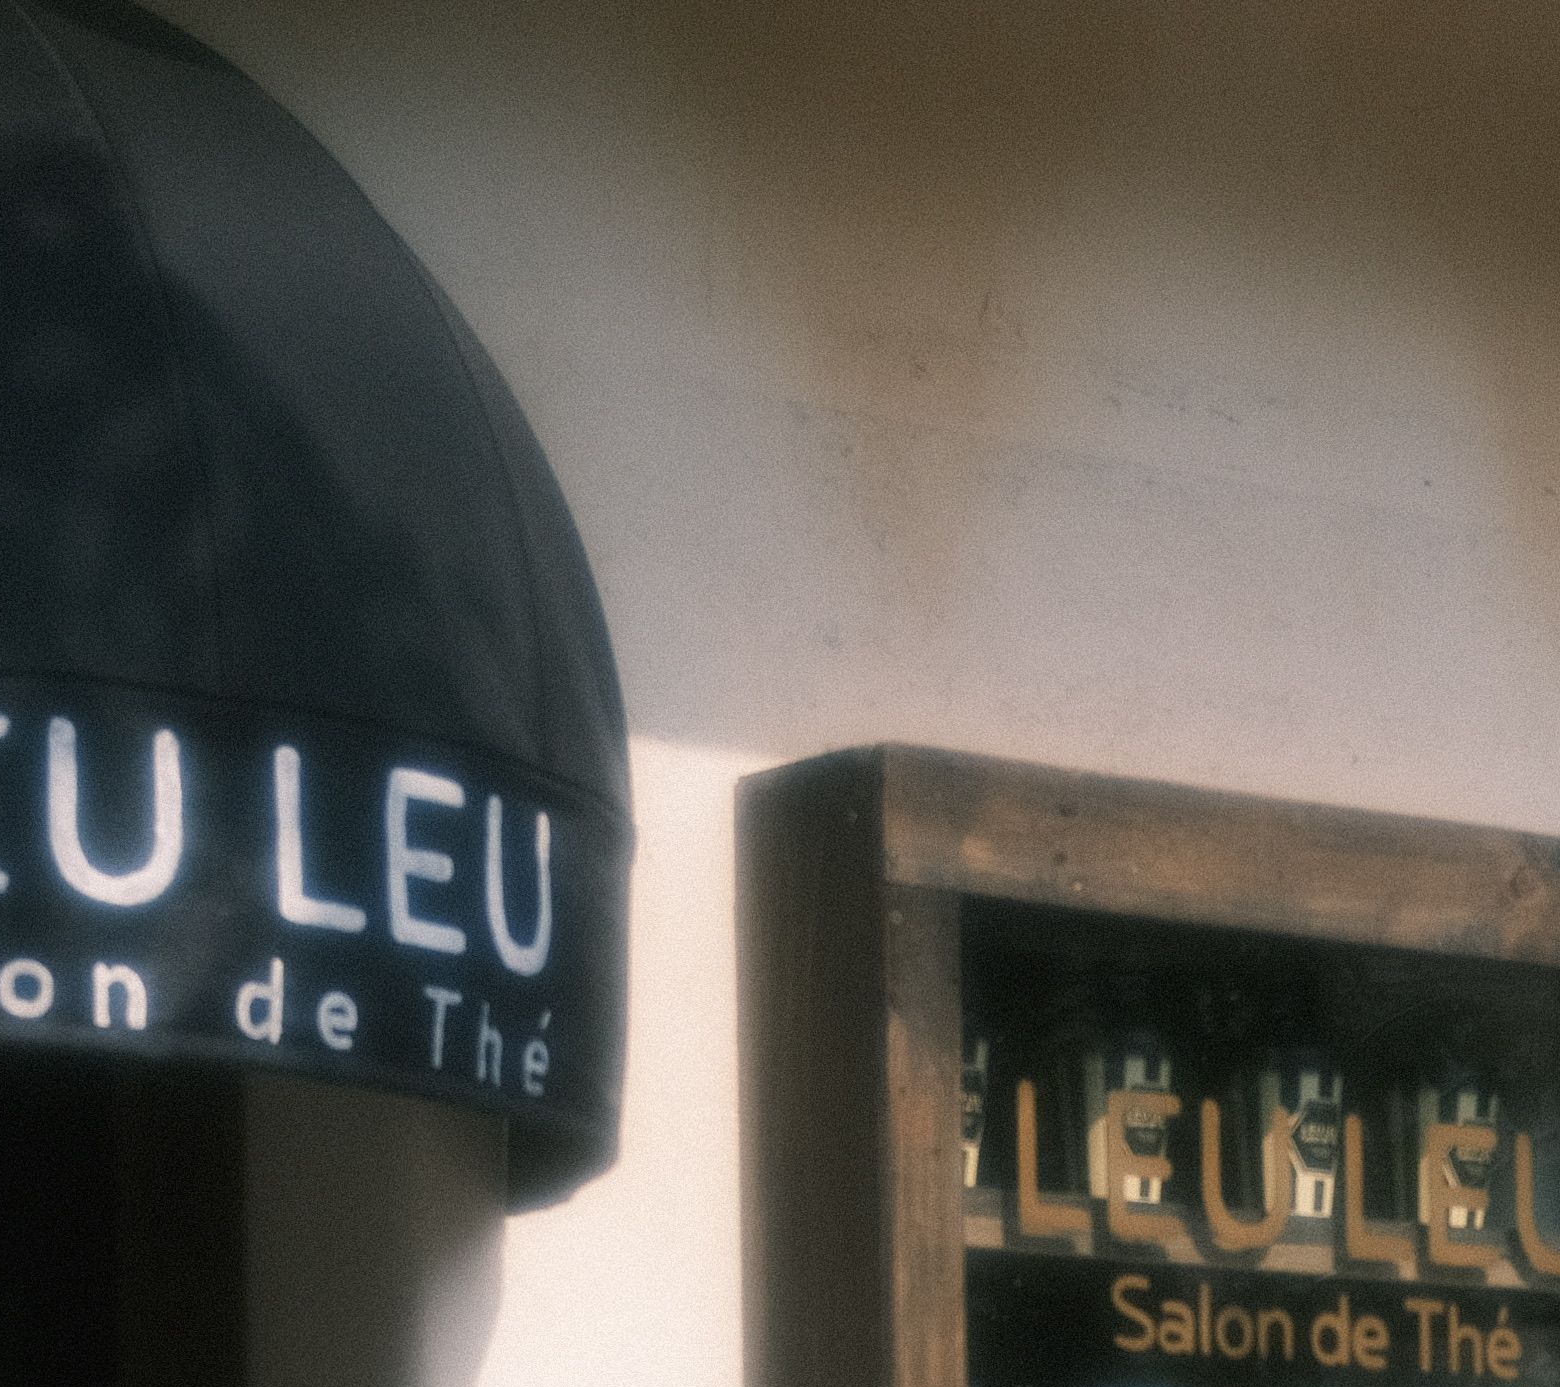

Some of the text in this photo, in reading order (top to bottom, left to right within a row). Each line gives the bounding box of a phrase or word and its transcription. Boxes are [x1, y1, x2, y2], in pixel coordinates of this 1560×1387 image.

[274, 744, 553, 977] LEU
[235, 956, 359, 1051] de
[424, 986, 553, 1096] Thé
[1016, 1078, 1293, 1252] LEU
[1111, 1275, 1524, 1380] Salon de Thé
